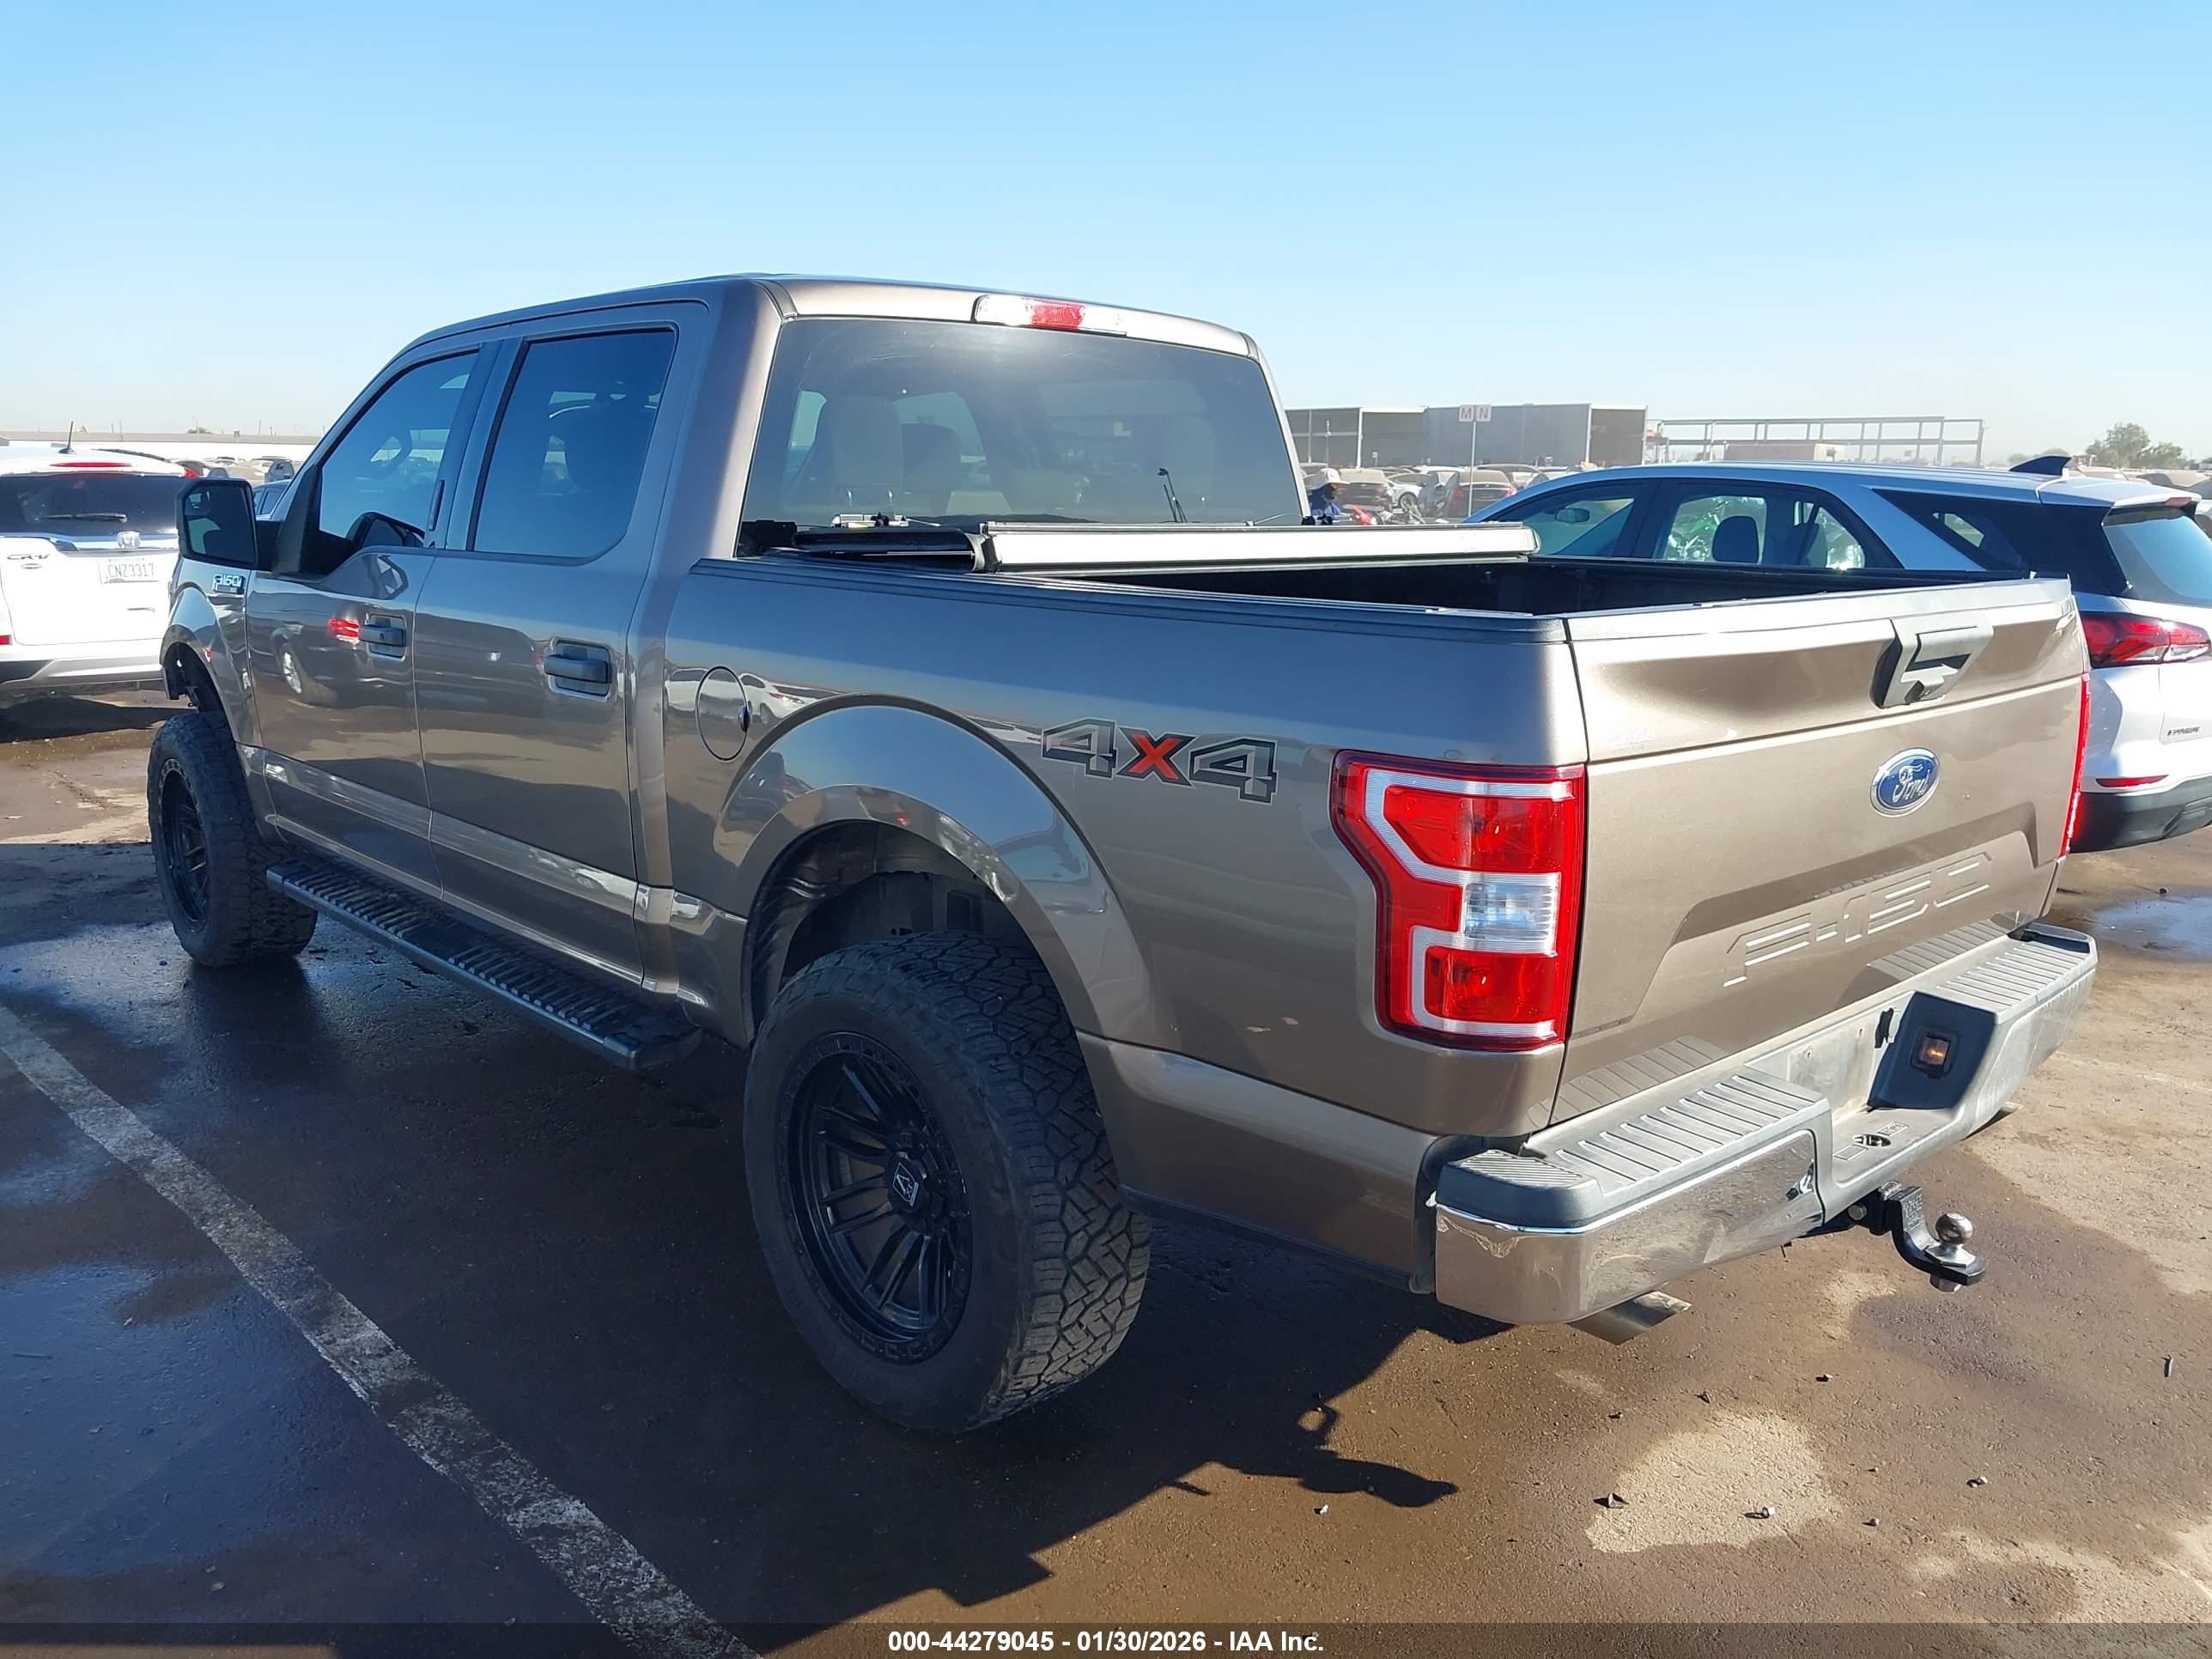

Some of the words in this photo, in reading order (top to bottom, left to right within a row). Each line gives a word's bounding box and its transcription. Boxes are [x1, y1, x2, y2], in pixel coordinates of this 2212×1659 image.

[1461, 407, 1472, 419] M
[1480, 407, 1488, 419] N
[1892, 763, 1930, 803] Ford
